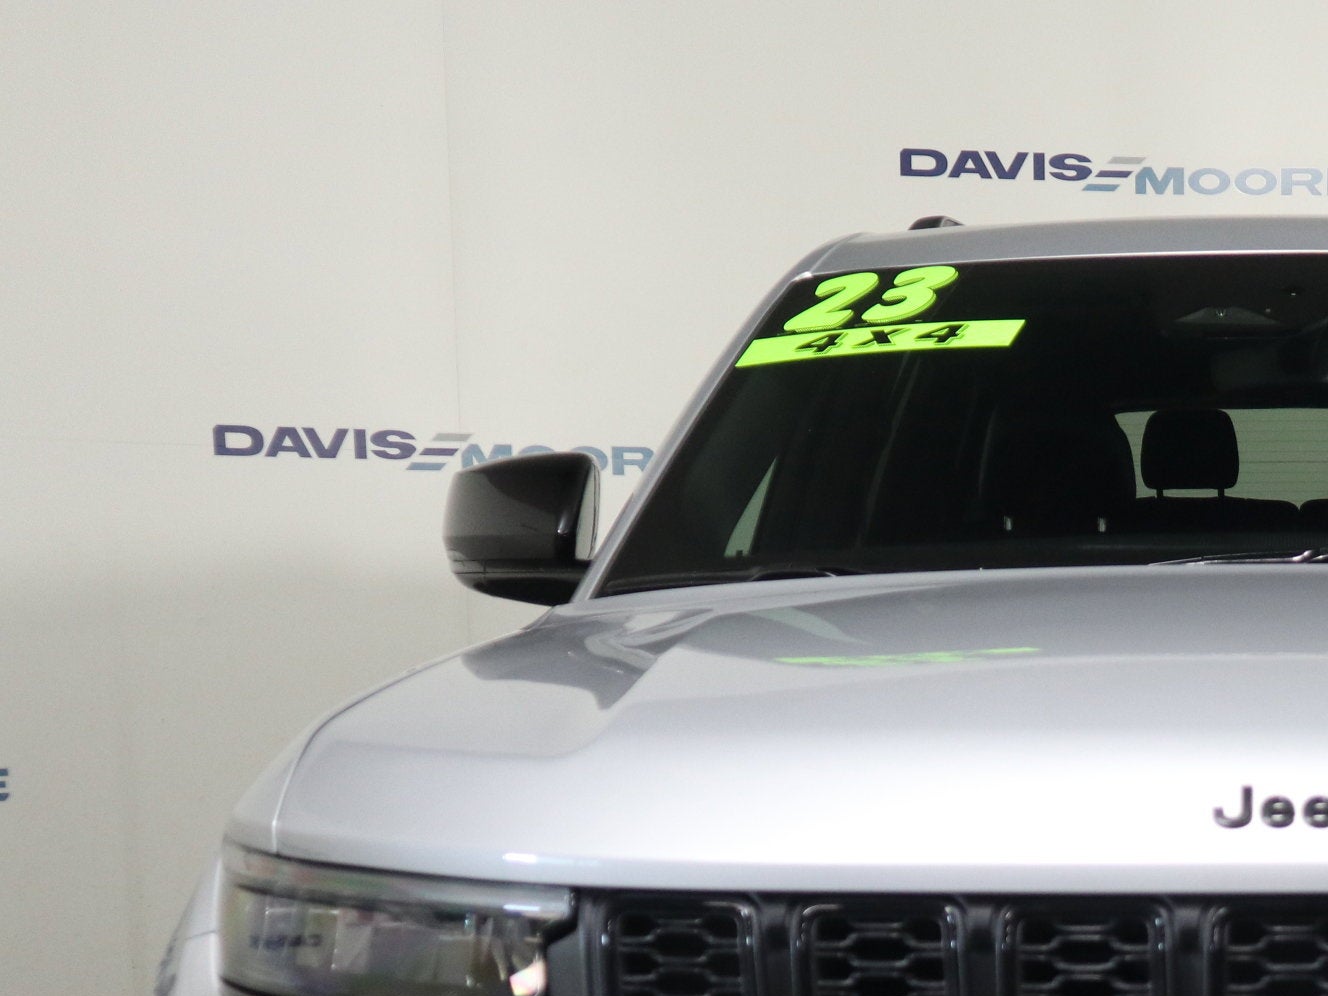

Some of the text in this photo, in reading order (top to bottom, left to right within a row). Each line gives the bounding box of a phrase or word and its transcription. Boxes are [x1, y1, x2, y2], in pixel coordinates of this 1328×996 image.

[899, 147, 1092, 182] DAVIS
[783, 265, 959, 333] 23
[212, 424, 418, 461] DAVIS
